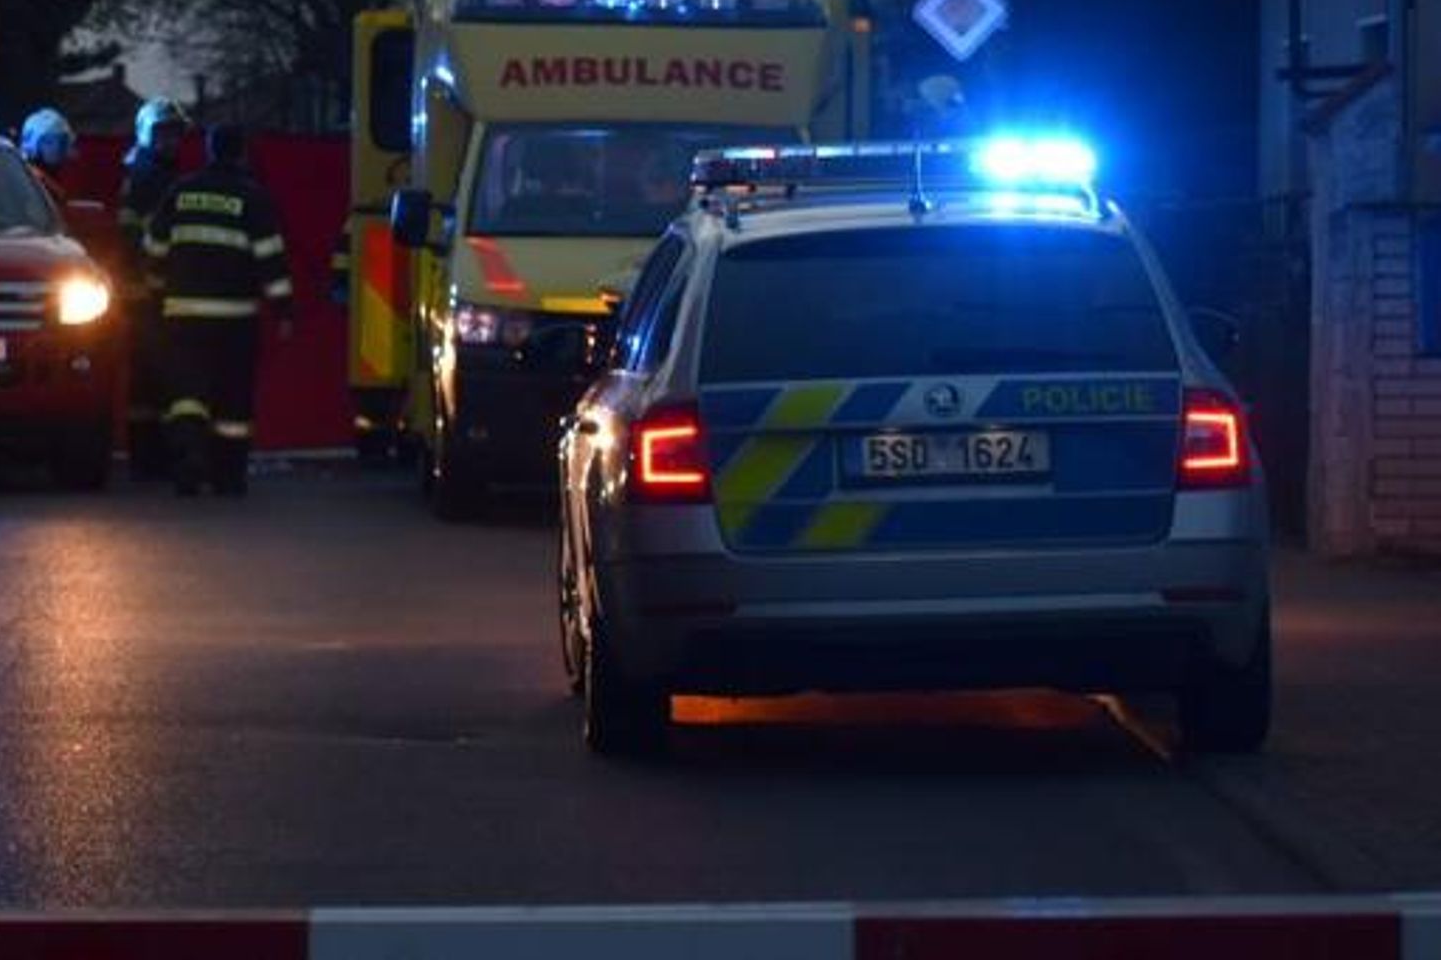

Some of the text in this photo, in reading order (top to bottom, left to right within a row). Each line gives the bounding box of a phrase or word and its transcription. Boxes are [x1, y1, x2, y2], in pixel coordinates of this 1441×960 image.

[499, 56, 785, 93] AMBULANCE
[1022, 383, 1155, 414] POLICIE
[960, 435, 1034, 469] 1624
